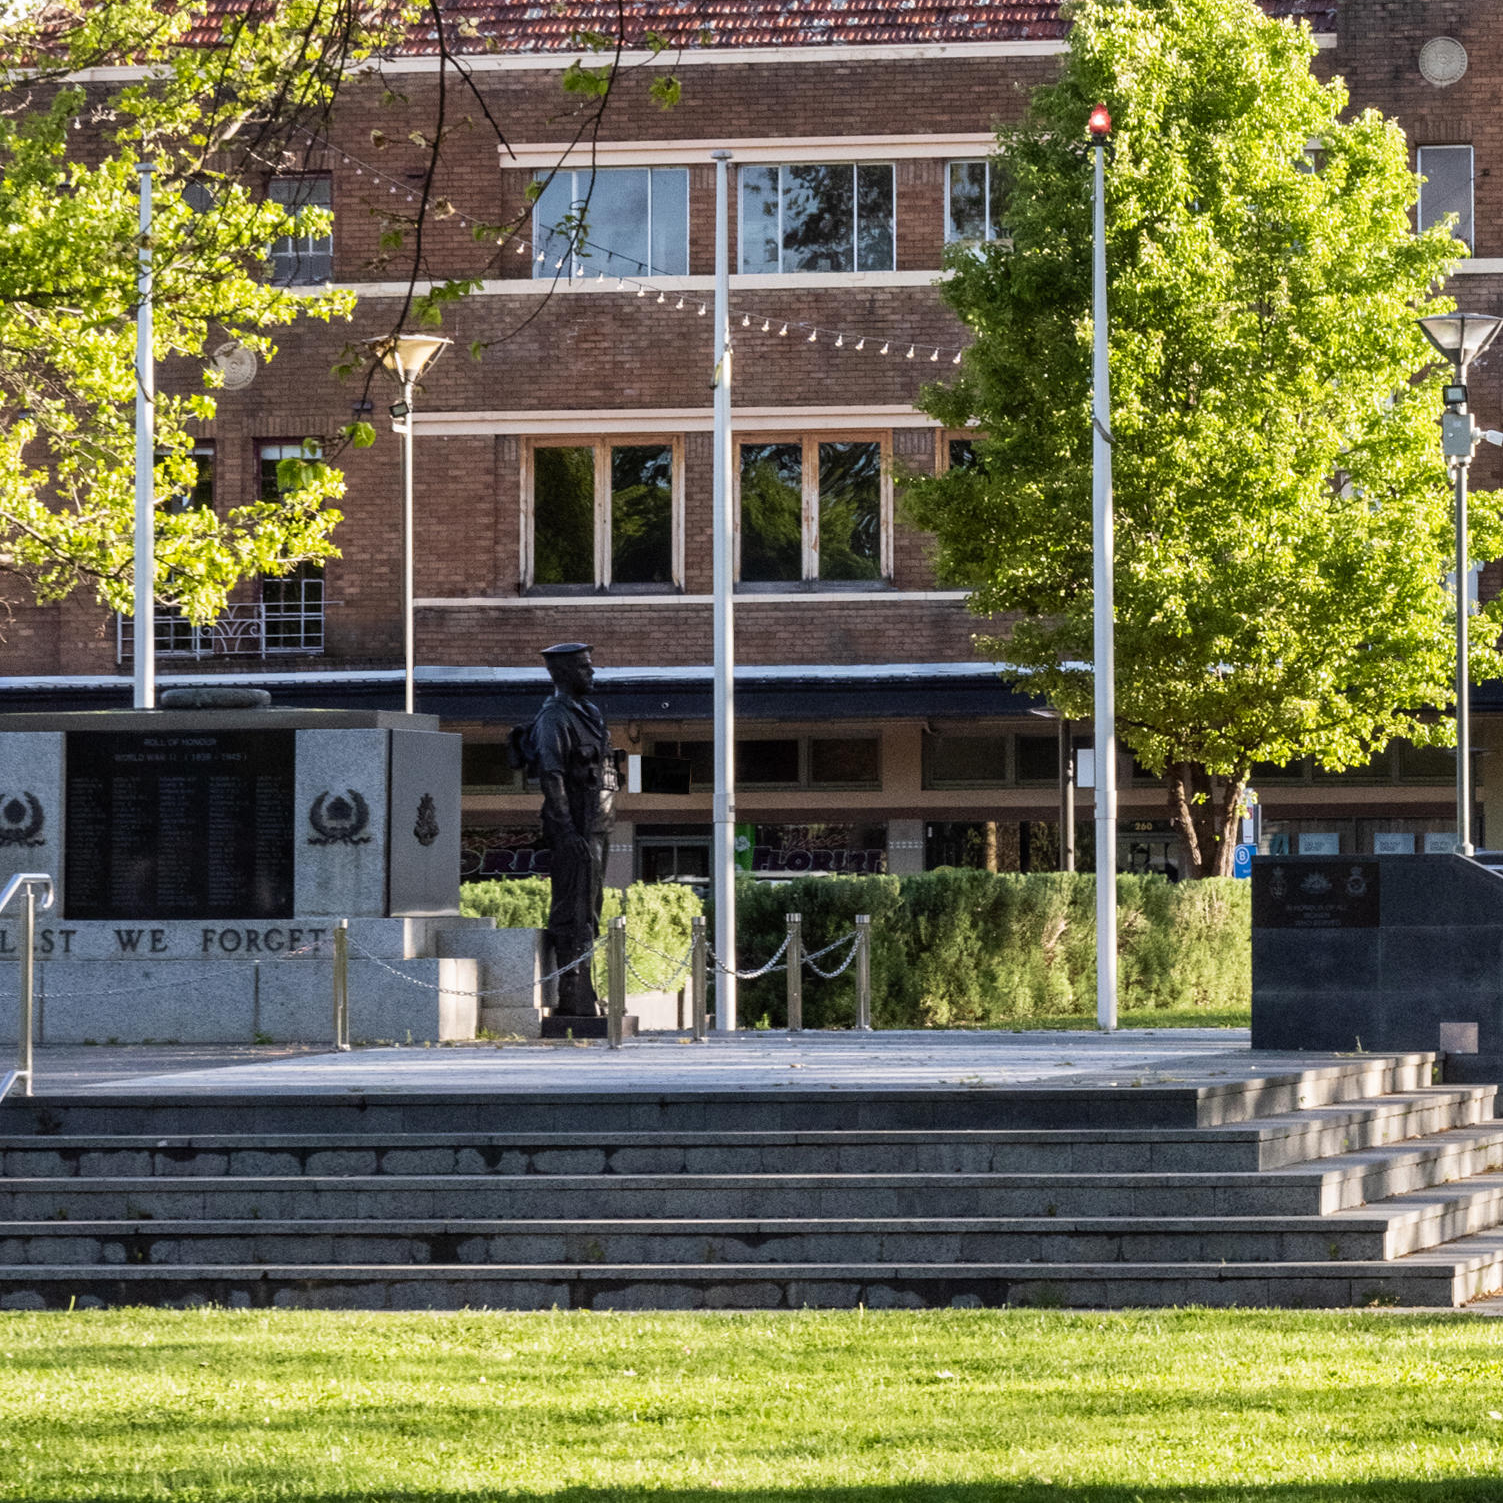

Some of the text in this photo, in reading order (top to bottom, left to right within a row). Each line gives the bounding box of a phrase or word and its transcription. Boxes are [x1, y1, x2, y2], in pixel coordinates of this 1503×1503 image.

[143, 738, 217, 746] ROLL OF HONOUR
[114, 753, 144, 761] WORLD
[145, 753, 166, 761] WAR
[1135, 822, 1153, 831] 260
[0, 928, 328, 954] LST WE FORGET
